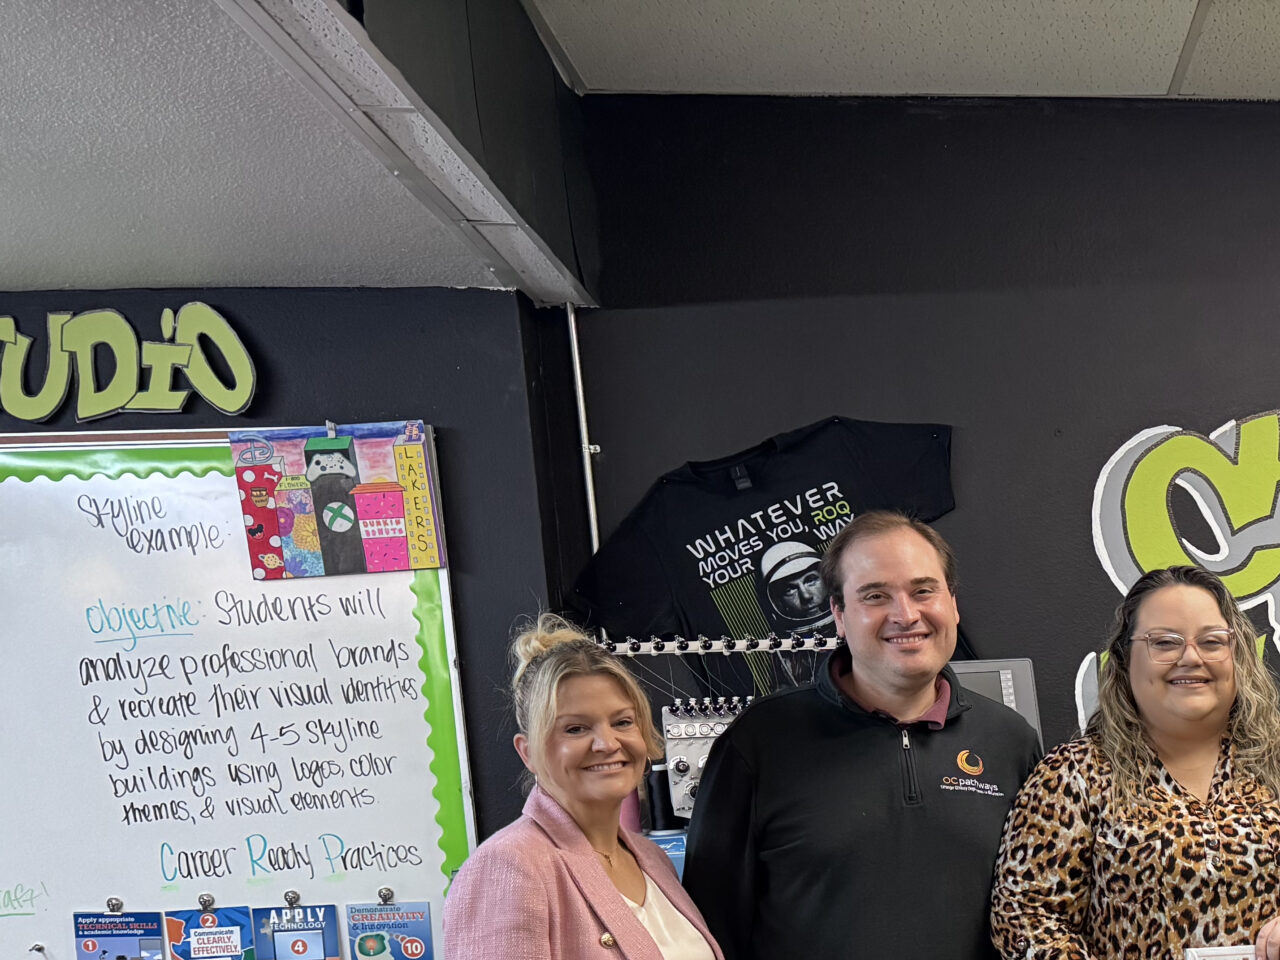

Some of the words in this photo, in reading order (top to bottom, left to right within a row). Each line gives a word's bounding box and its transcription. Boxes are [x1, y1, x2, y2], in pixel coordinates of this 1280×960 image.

[362, 519, 401, 528] DUNKIN
[686, 481, 844, 560] WHATEVER
[365, 528, 404, 537] DONUTS
[698, 535, 763, 576] MOVES
[766, 518, 809, 544] YOU,
[811, 500, 850, 525] ROQ
[702, 557, 755, 589] YOUR
[214, 590, 331, 626] Students
[339, 588, 386, 619] will
[79, 652, 175, 695] analyze
[180, 643, 318, 685] professional
[328, 638, 409, 669] brands
[88, 695, 110, 726] &
[119, 691, 200, 720] recreate
[208, 683, 261, 718] their
[269, 678, 333, 708] visual
[341, 675, 418, 704] identities
[98, 731, 129, 770] by
[135, 725, 239, 760] designing
[251, 722, 300, 753] 4-5
[108, 765, 216, 798] buildings
[228, 762, 282, 793] using
[291, 757, 345, 788] logos,
[350, 752, 397, 777] color
[959, 778, 999, 792] pathways
[122, 800, 196, 825] themes,
[200, 796, 215, 820] &
[226, 791, 288, 816] visual
[160, 842, 236, 881] Career
[245, 833, 314, 880] Ready
[318, 833, 423, 874] Practices
[204, 916, 214, 927] 2
[269, 908, 325, 924] APPLY
[351, 912, 425, 922] CREATIVITY
[193, 929, 234, 937] Communicate
[270, 921, 326, 930] TECHNOLOGY
[361, 922, 409, 930] Innovation
[86, 941, 93, 951] 1
[294, 941, 305, 953] 4
[405, 942, 422, 954] 10
